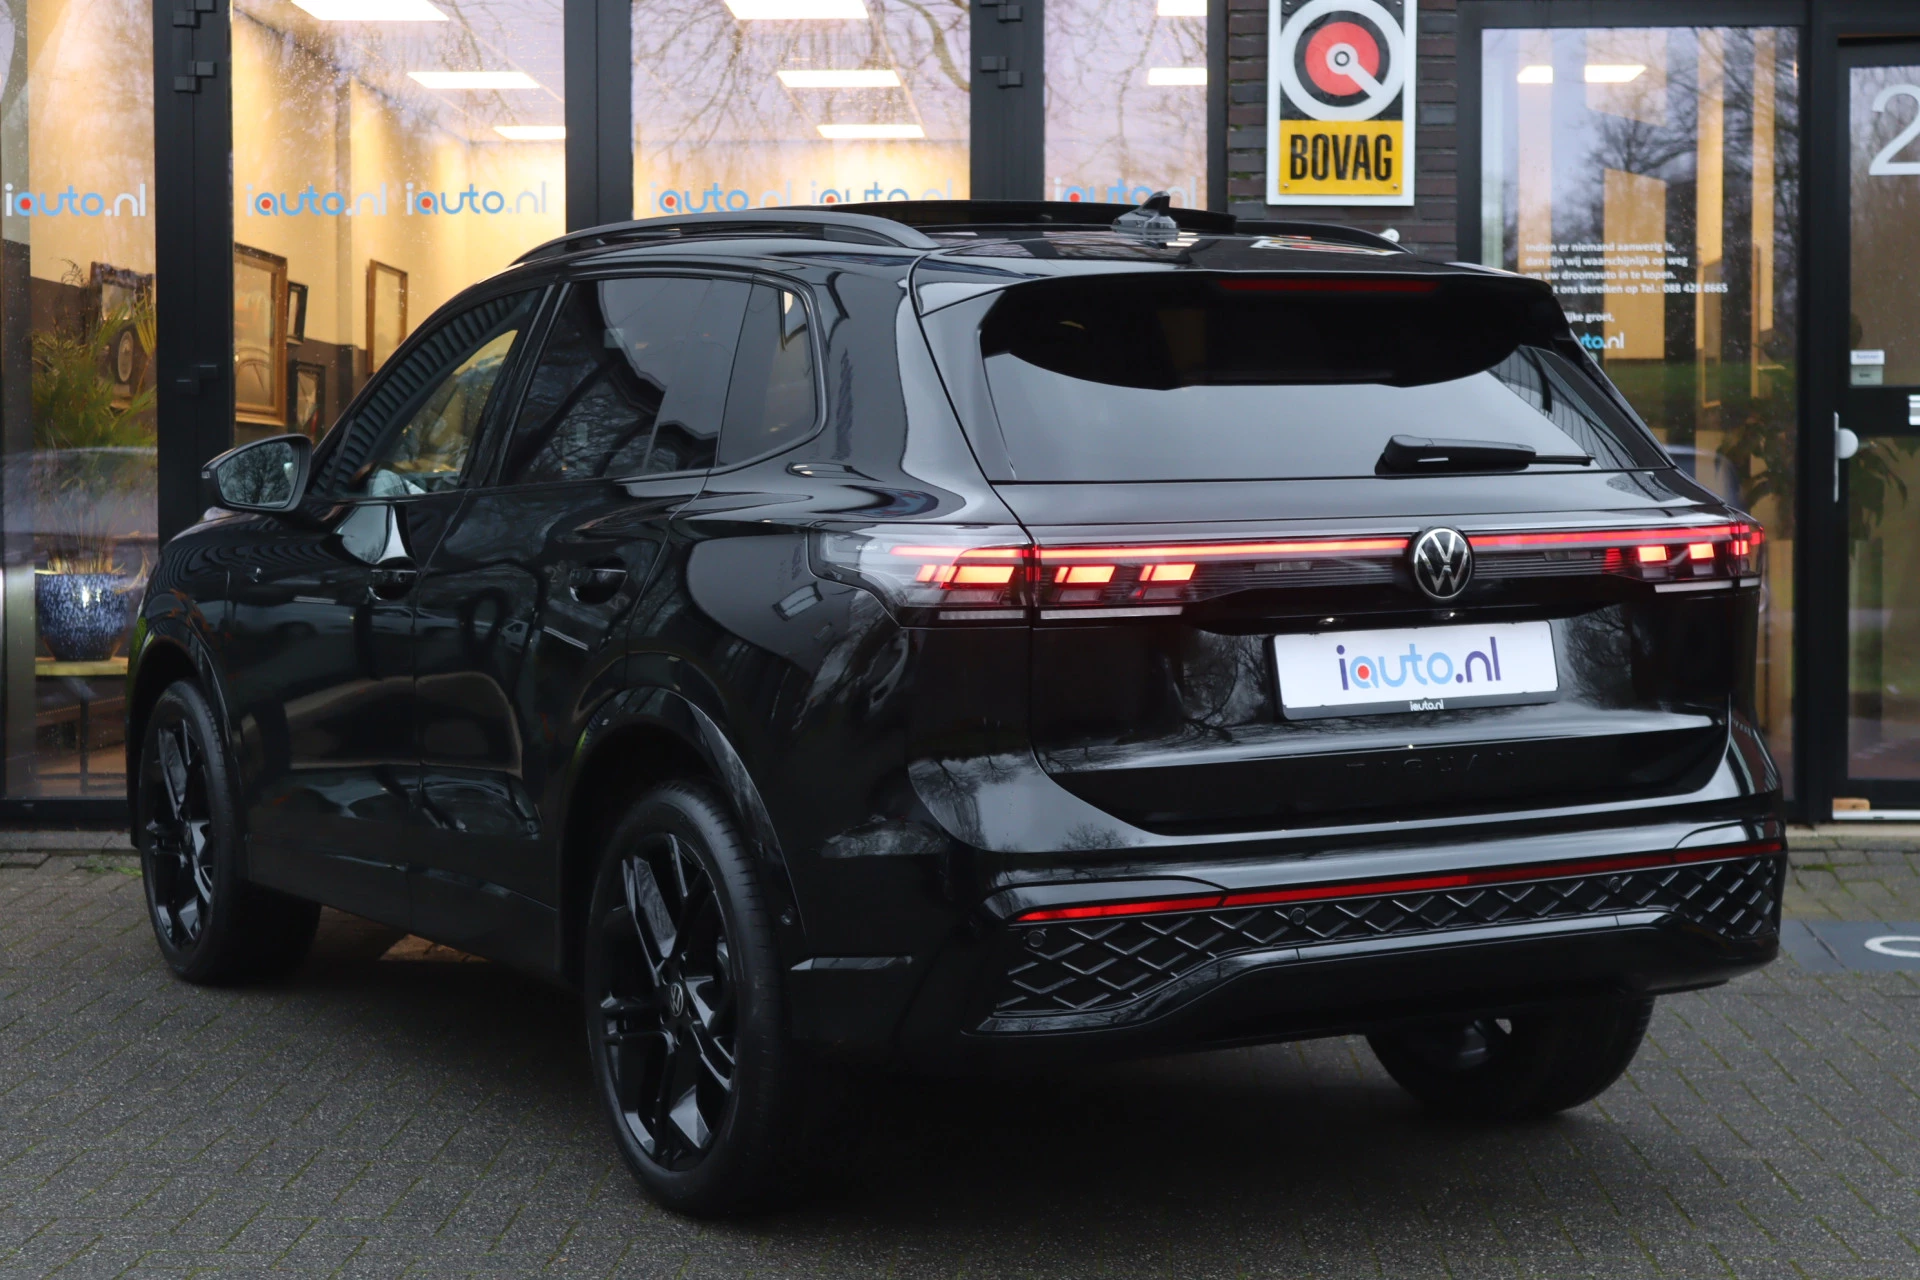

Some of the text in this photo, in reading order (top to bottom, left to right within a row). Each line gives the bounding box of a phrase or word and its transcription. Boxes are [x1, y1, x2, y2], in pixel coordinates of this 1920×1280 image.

[1869, 84, 1920, 175] 2
[1290, 134, 1392, 181] BOVAG
[5, 183, 146, 217] iauto.nl
[245, 183, 387, 216] iauto.nl
[405, 181, 547, 216] iauto.nl
[1054, 176, 1197, 209] iautonl
[1525, 242, 1676, 253] Indien er niemand aanwezig is,
[1525, 256, 1688, 268] dan zijn wij waarschijnlijk op weg
[1544, 271, 1559, 280] uw
[1561, 270, 1616, 280] droomauto
[1619, 270, 1628, 279] in
[1630, 270, 1641, 280] te
[1643, 270, 1677, 281] kopen.
[1560, 286, 1578, 294] ons
[1579, 284, 1623, 294] bereiken
[1625, 286, 1638, 295] op
[1662, 283, 1681, 293] 088
[1585, 311, 1616, 324] groet,
[1336, 636, 1502, 690] iauto.nl
[1409, 699, 1445, 712] iauto.nl
